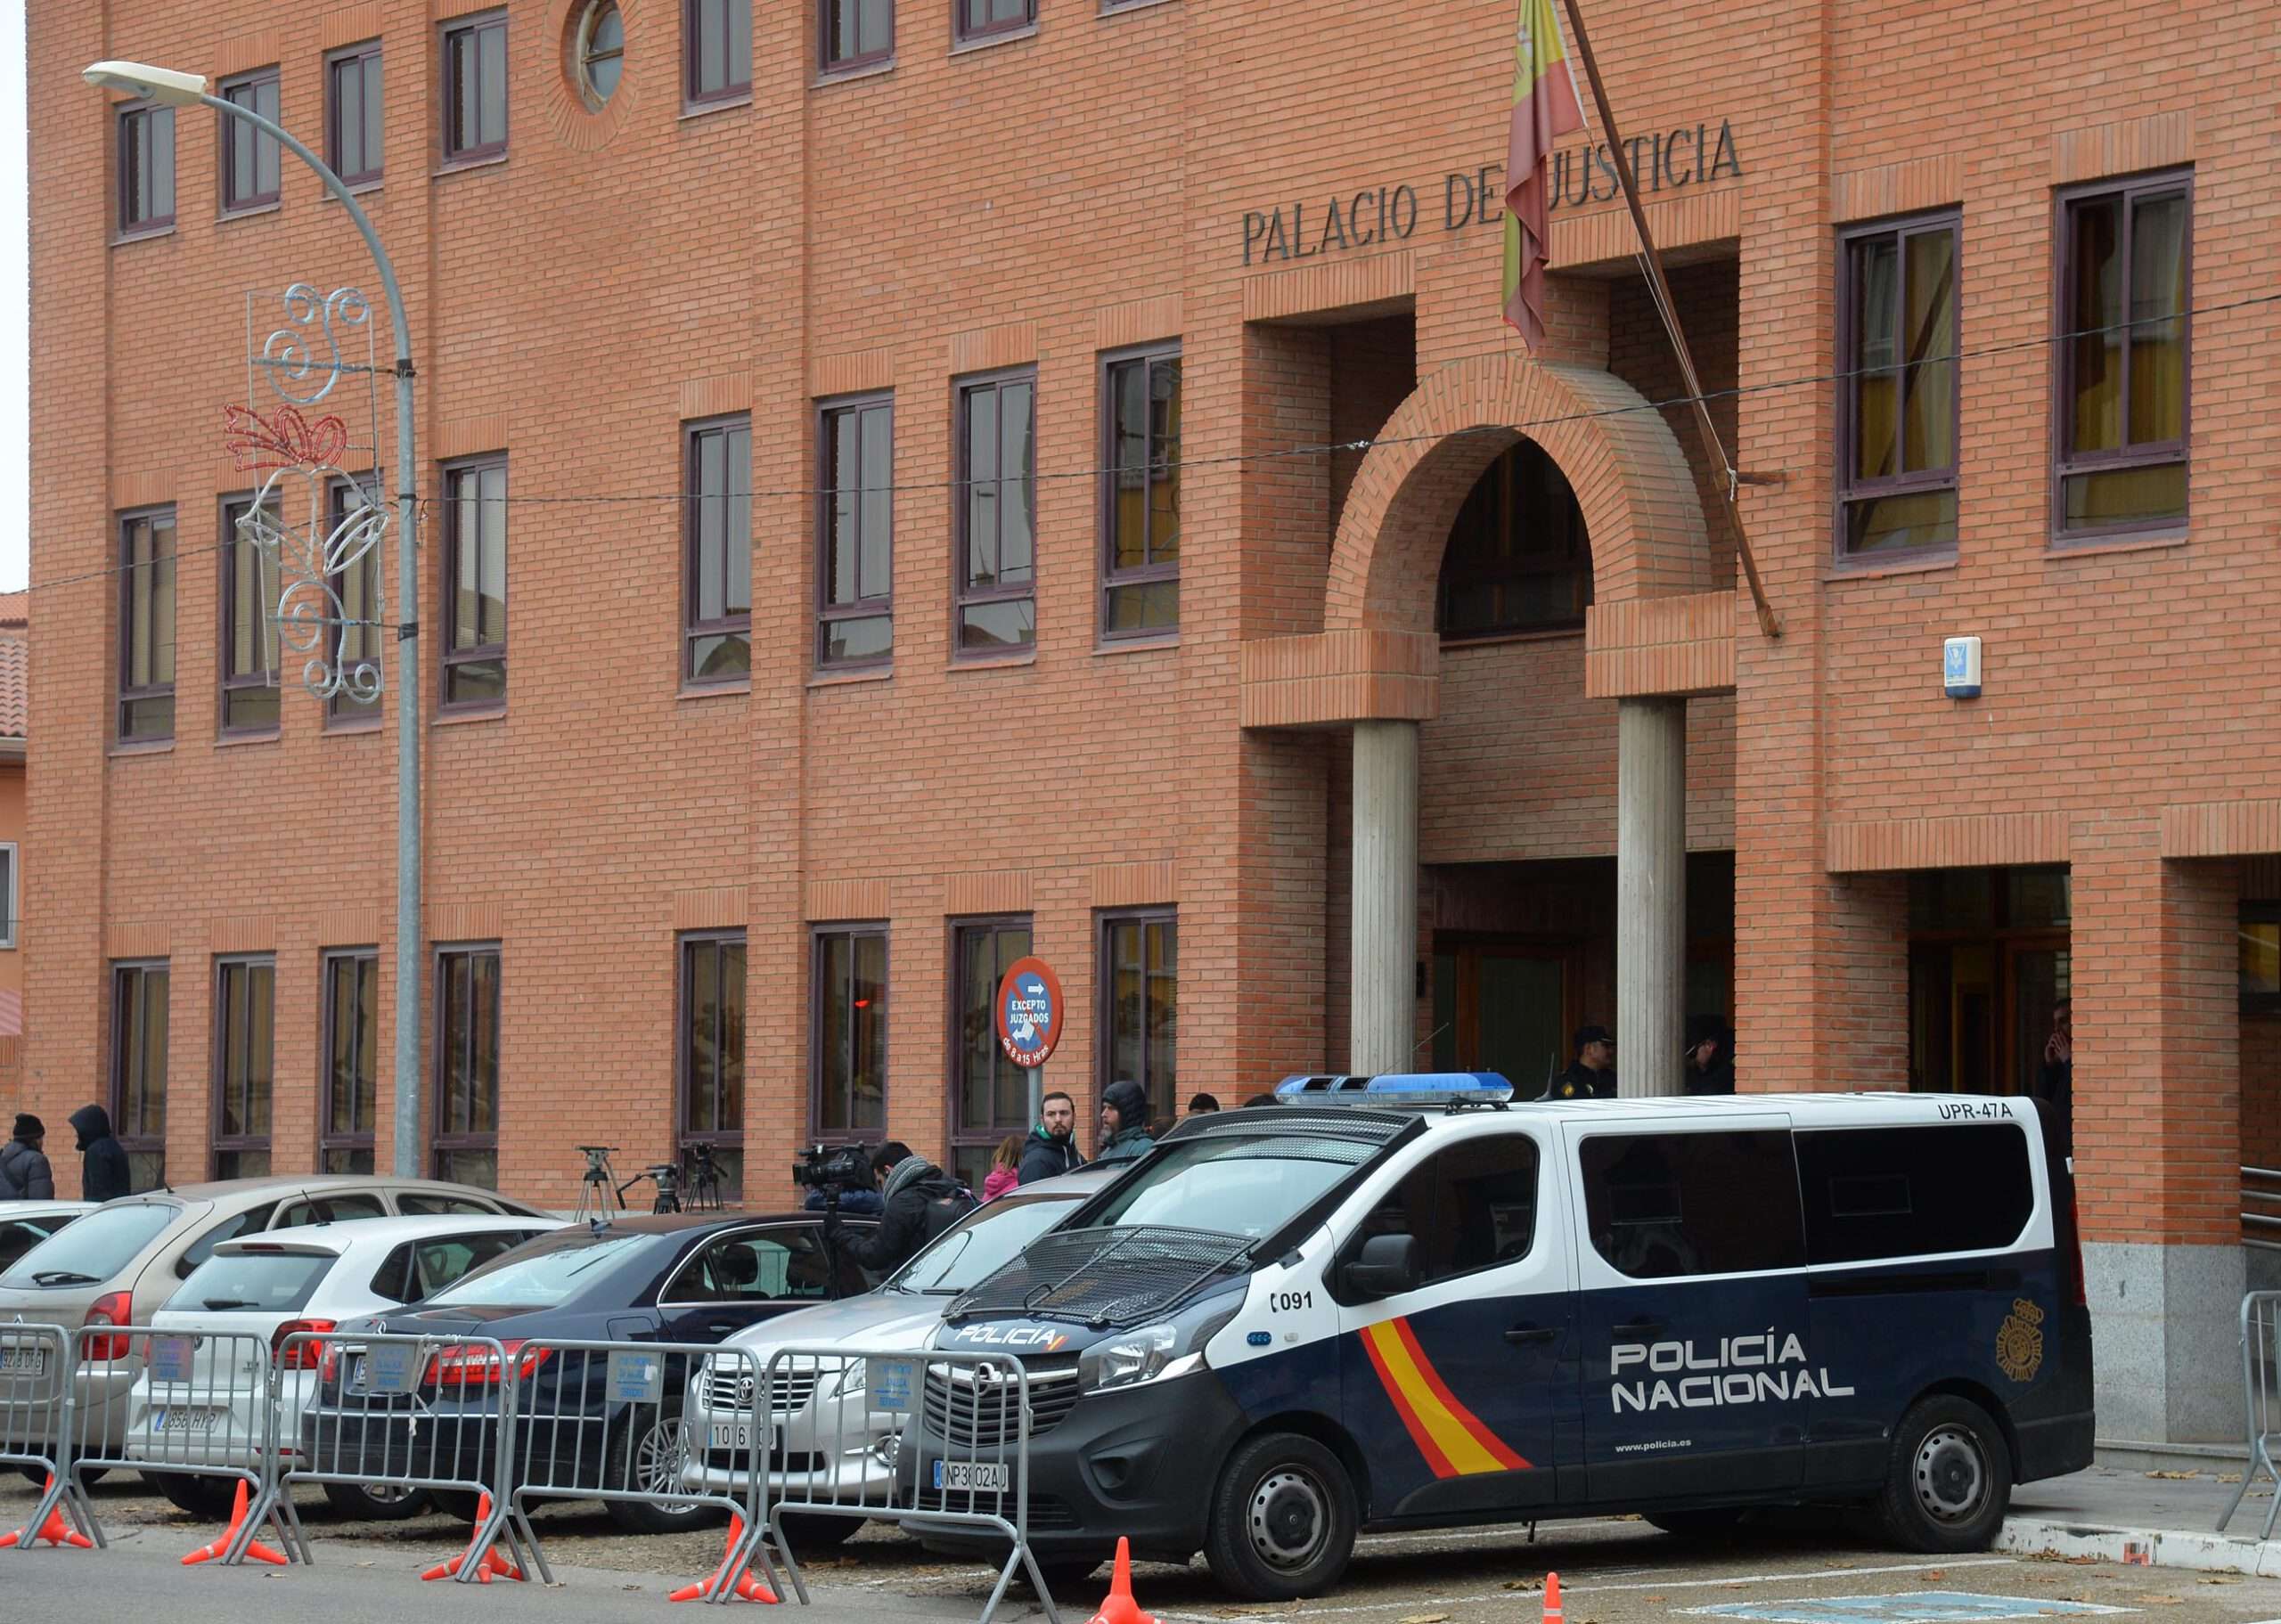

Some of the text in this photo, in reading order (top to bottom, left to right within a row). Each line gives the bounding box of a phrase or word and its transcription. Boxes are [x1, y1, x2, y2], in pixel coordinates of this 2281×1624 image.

[1242, 118, 1743, 266] PALACIO DE JUSTICIA
[1011, 1000, 1046, 1010] EXCEPTO
[1010, 1012, 1049, 1024] JUZGADOS
[1022, 1053, 1030, 1065] 15
[1937, 1102, 2014, 1120] UPR-47A
[1279, 1291, 1312, 1310] 091
[954, 1324, 1057, 1345] POLICÍA
[1611, 1326, 1807, 1375] POLICÍA
[1611, 1367, 1855, 1414] NACIONAL
[1615, 1437, 1692, 1453] www.policia.es
